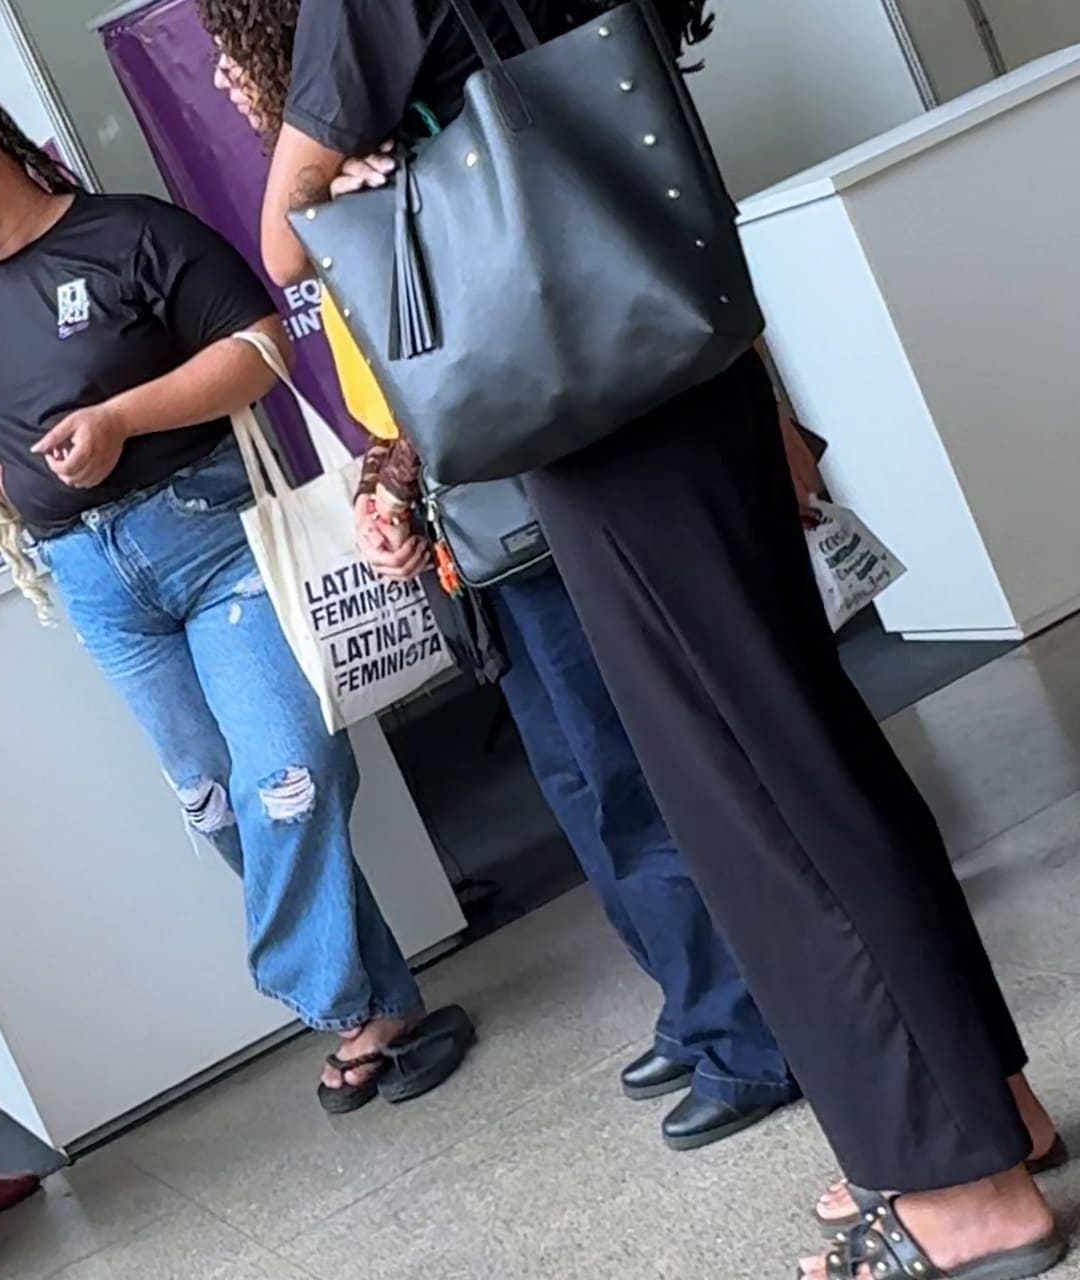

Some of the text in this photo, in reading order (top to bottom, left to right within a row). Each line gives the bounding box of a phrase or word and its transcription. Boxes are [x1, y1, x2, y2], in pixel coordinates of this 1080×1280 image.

[304, 560, 376, 604] LATIN
[330, 615, 412, 669] LATINA
[336, 632, 442, 697] FEMINISTA
